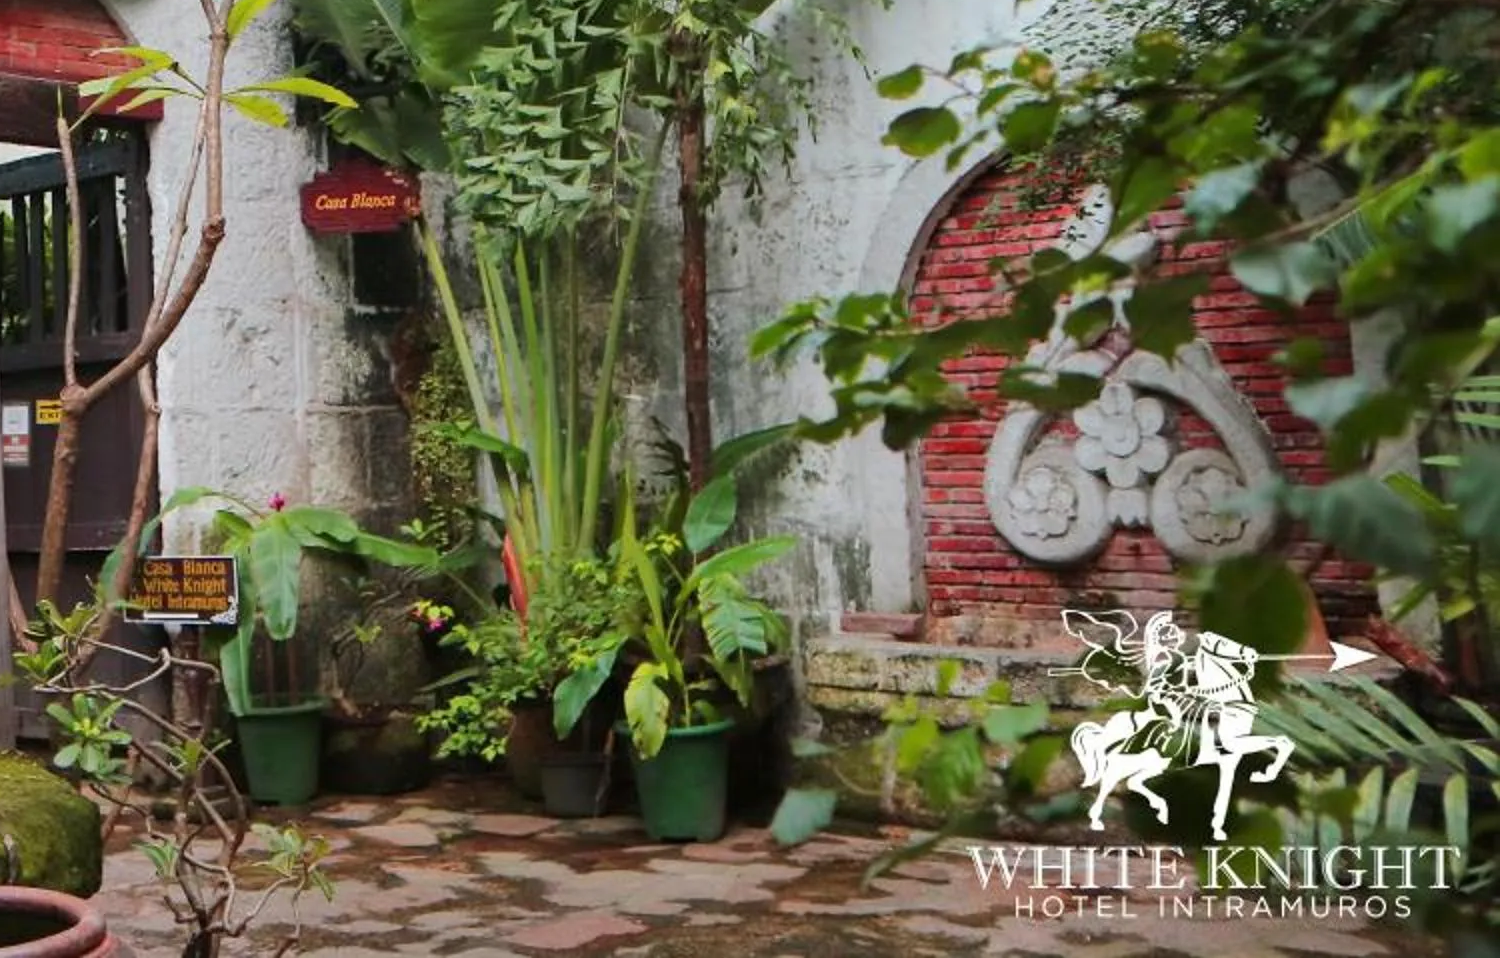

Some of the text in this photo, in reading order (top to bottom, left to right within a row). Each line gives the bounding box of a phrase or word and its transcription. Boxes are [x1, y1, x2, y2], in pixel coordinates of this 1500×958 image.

[315, 192, 396, 210] Casa Blanca
[143, 560, 225, 575] Casa Blanca
[143, 577, 226, 595] White Knight
